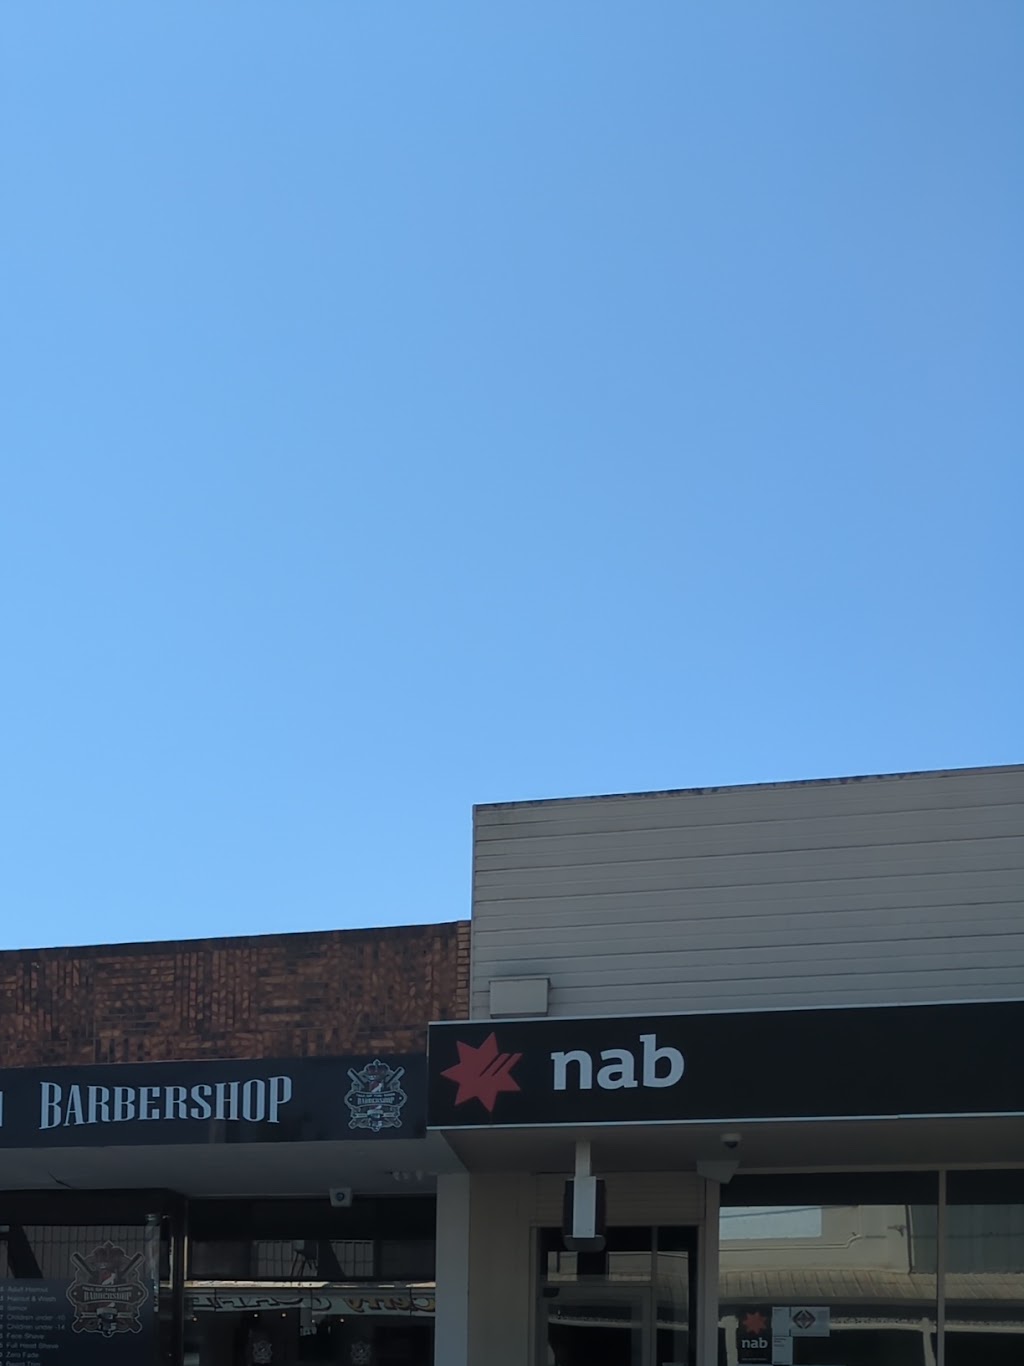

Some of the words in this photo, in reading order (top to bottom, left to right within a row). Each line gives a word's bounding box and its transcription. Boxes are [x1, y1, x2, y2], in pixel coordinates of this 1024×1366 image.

[550, 1034, 685, 1091] nab
[38, 1075, 293, 1130] BARBERSHOP
[741, 1337, 768, 1349] nab
